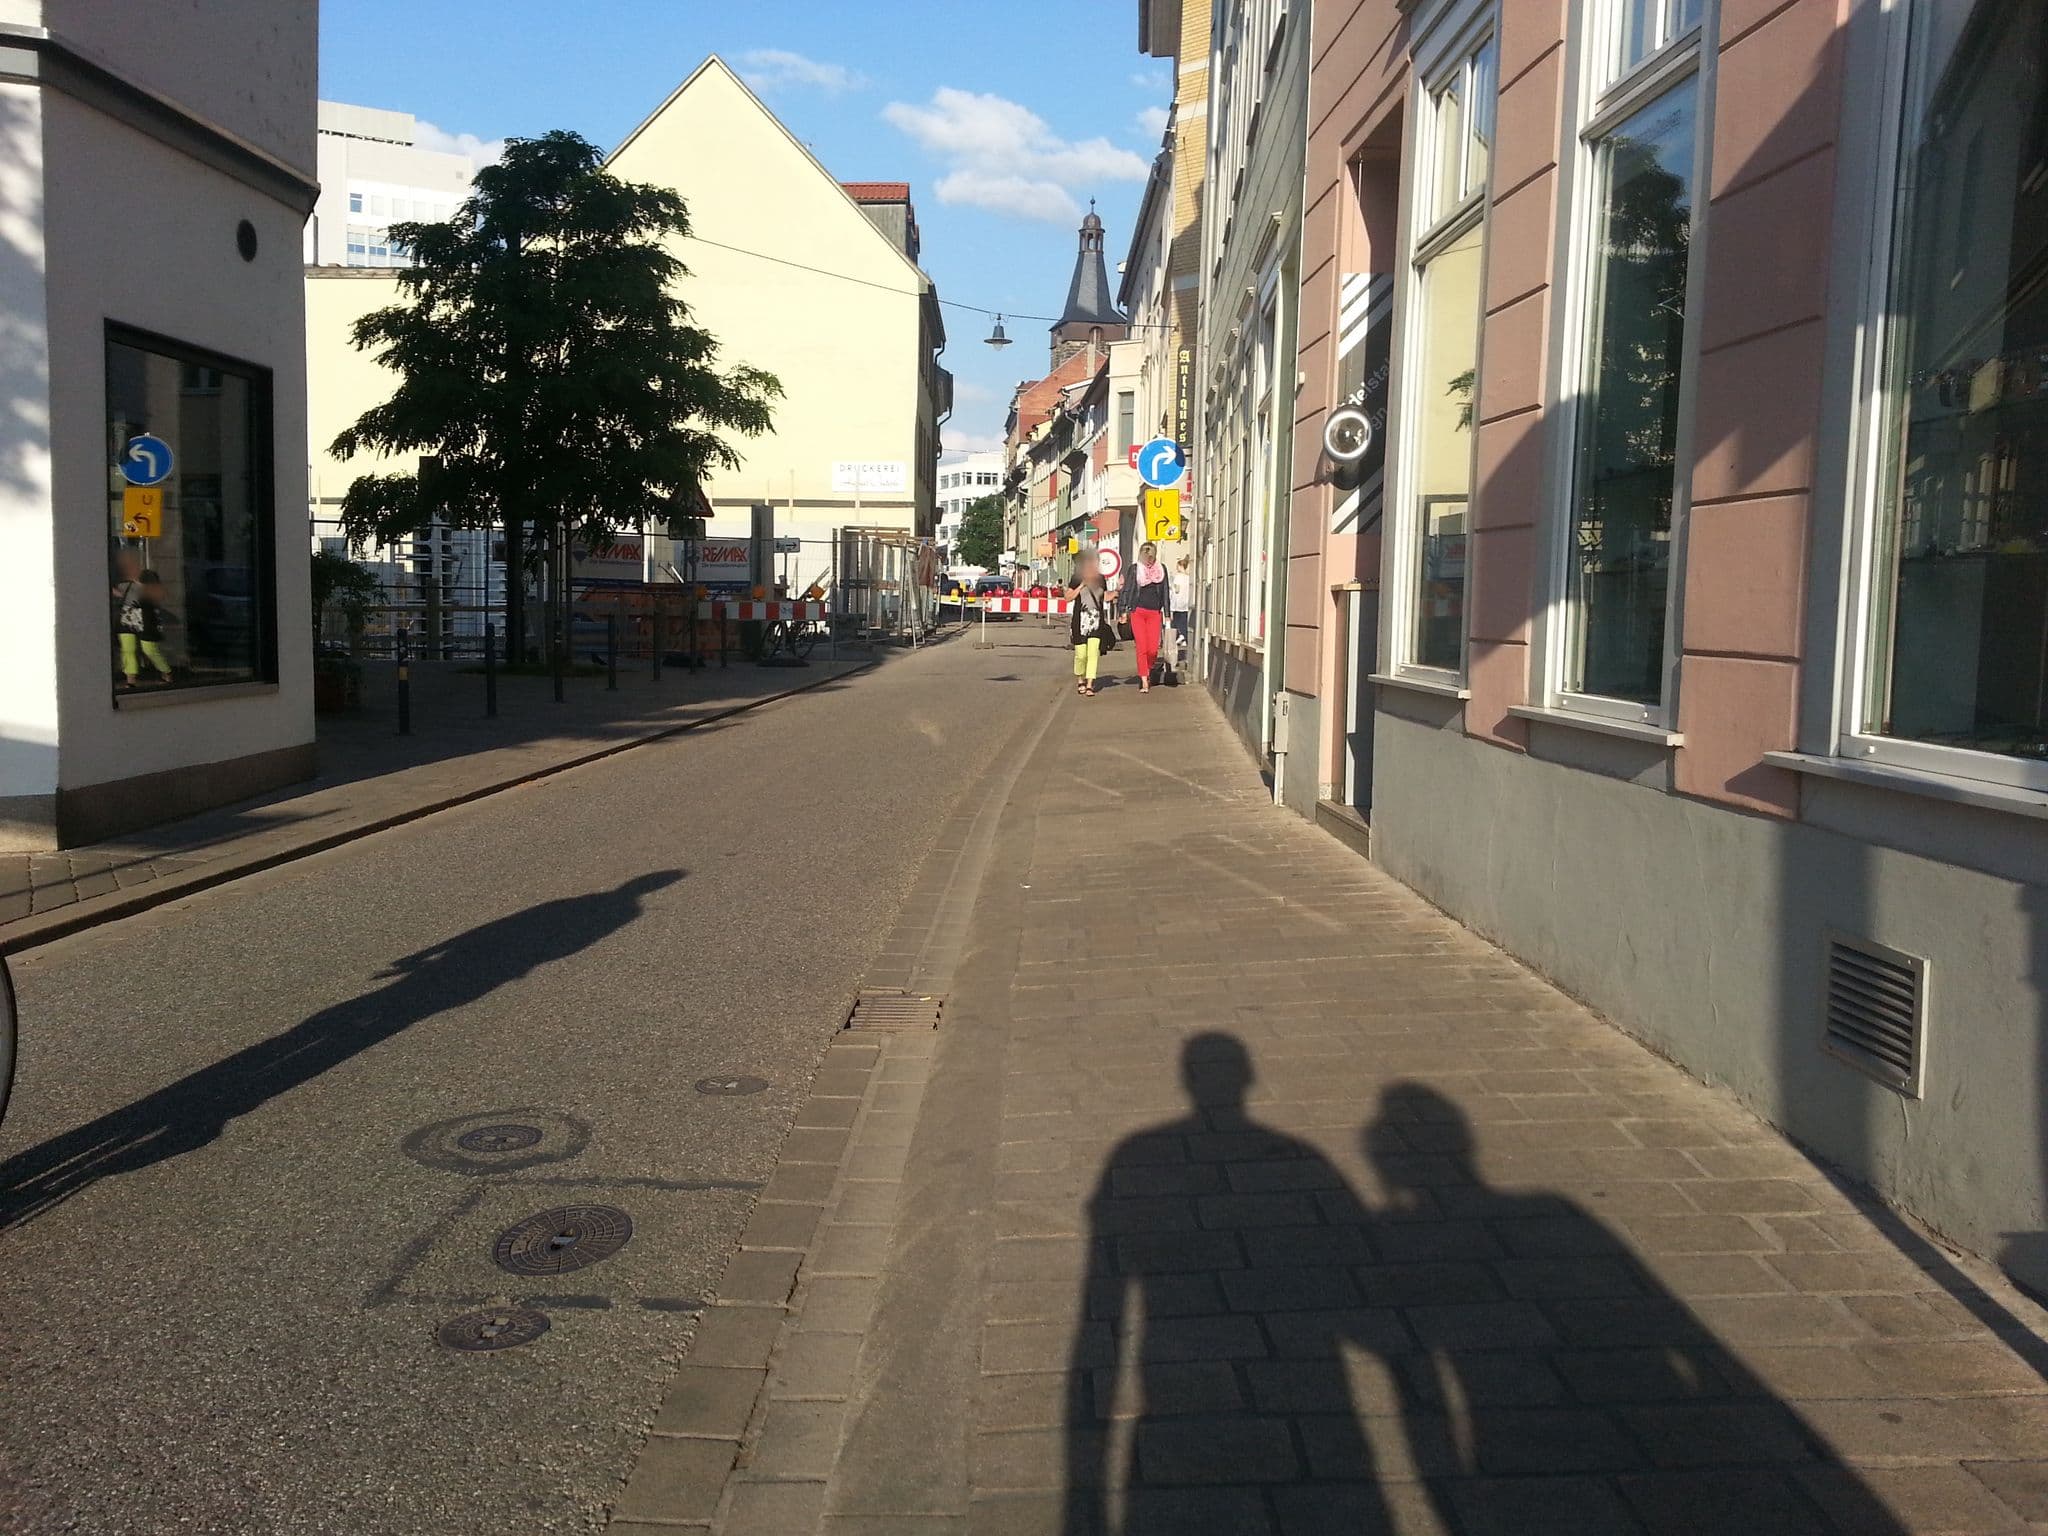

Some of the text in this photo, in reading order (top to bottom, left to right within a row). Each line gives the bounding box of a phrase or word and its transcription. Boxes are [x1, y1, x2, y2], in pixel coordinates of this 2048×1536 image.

[1178, 349, 1190, 443] Antiques
[1154, 496, 1162, 509] U
[702, 546, 748, 562] RE/MAX
